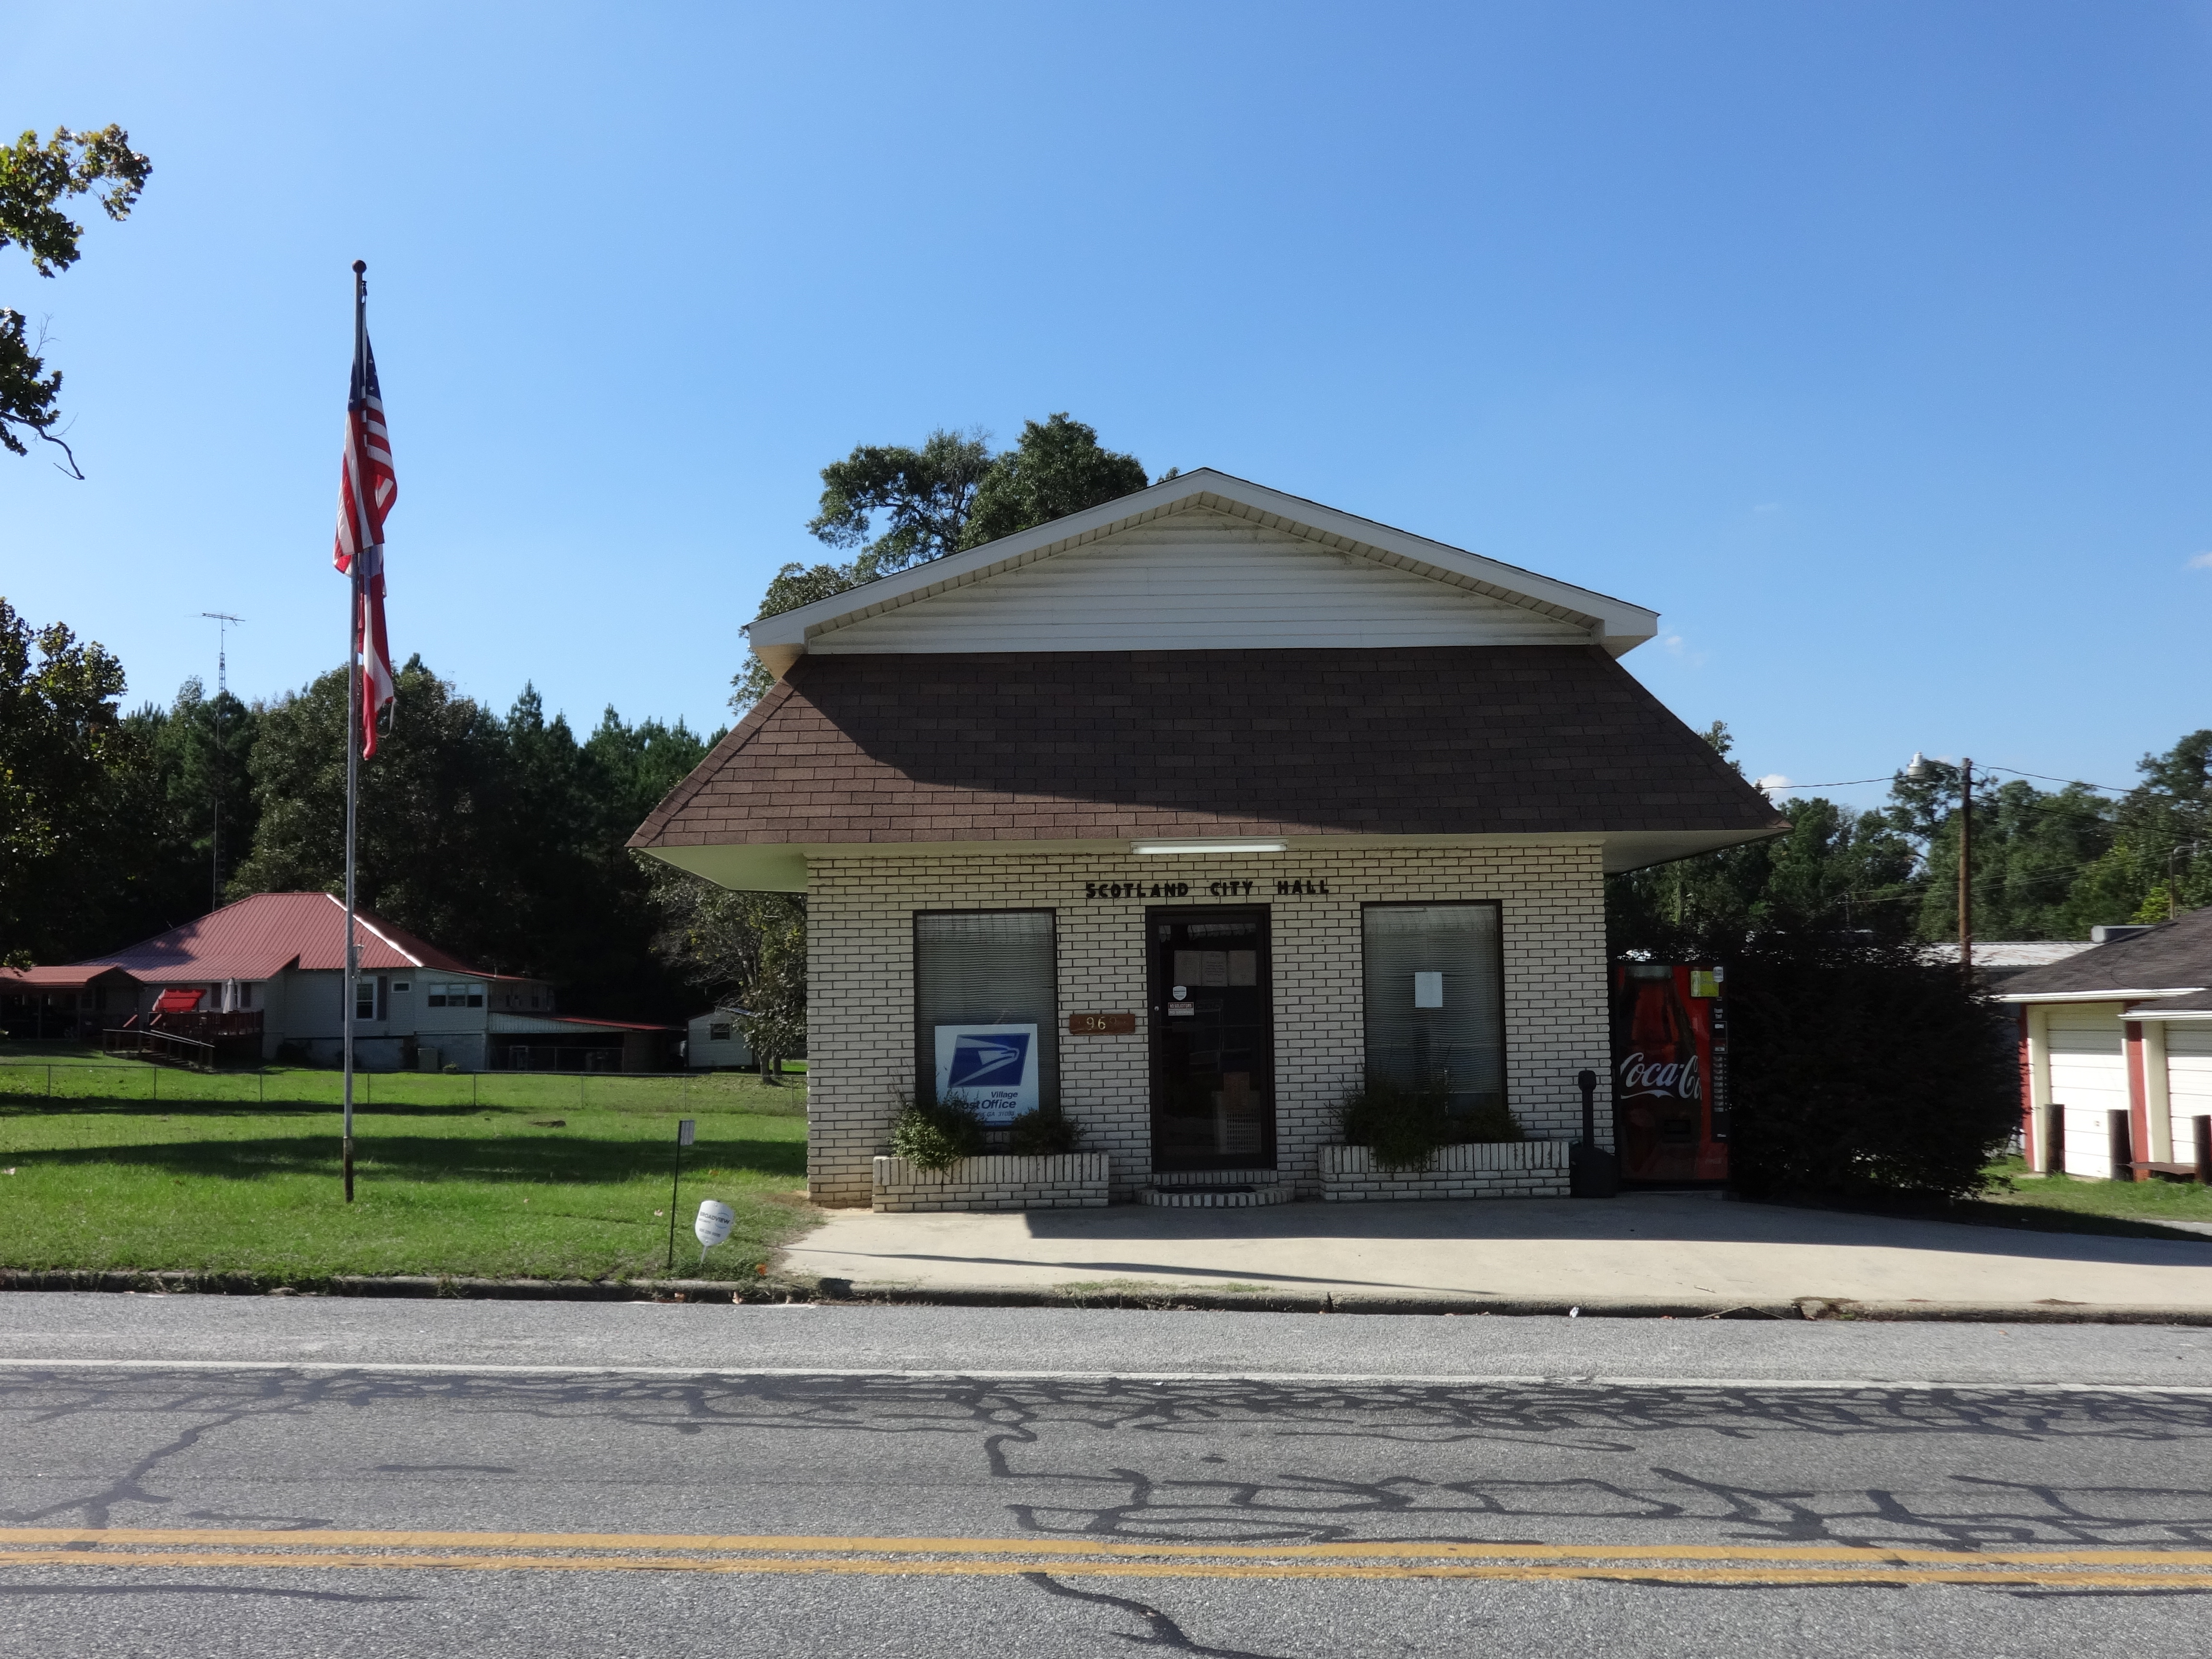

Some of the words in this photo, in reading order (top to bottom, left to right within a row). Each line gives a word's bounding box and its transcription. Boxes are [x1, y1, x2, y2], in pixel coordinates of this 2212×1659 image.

[1086, 883, 1188, 898] SCOTLAND
[1210, 881, 1253, 896] CITY
[1277, 880, 1329, 895] HALL
[991, 1091, 1018, 1099] Village
[954, 1100, 980, 1109] ost
[981, 1099, 1016, 1109] Office
[699, 1211, 731, 1224] BROADVIEW
